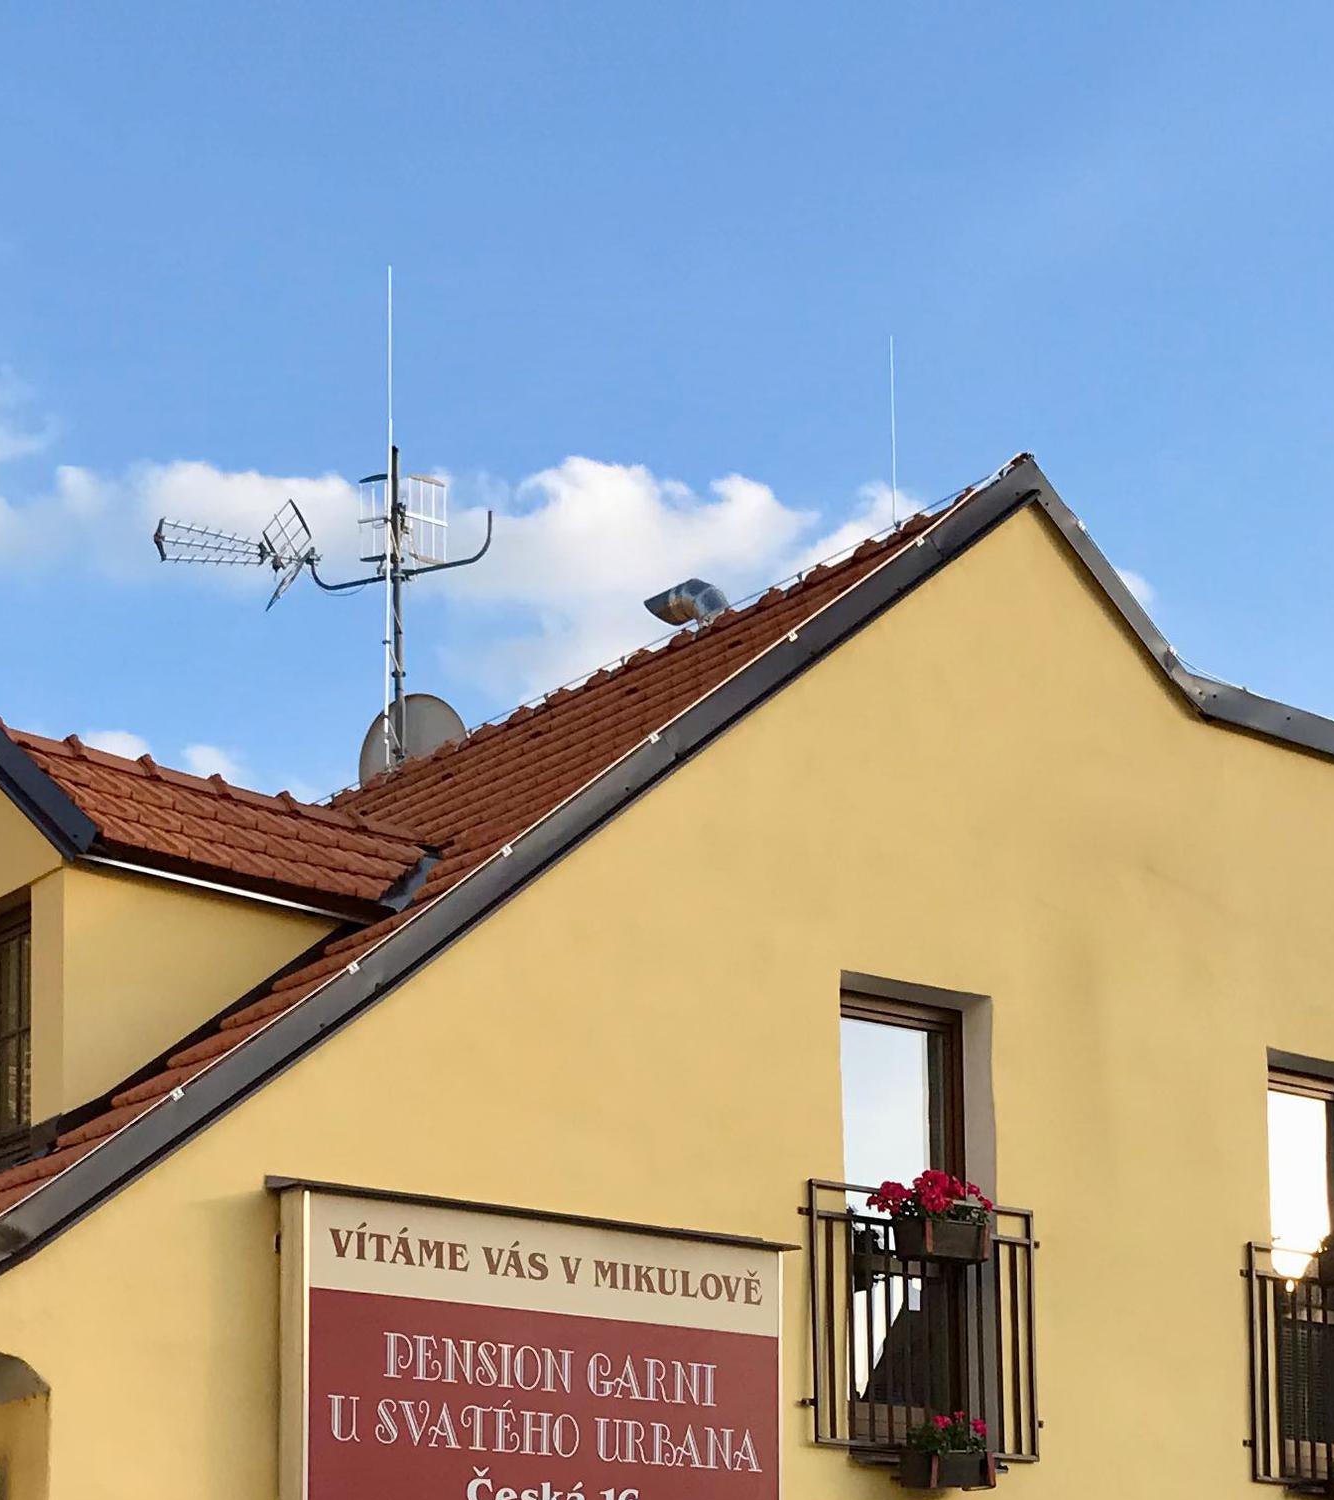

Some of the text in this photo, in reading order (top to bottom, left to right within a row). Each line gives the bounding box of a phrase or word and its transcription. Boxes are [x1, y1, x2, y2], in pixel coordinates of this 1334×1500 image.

[328, 1223, 764, 1306] VÍTÁME VÁS V MIKULOVĚ
[382, 1331, 718, 1407] PENSION GARNI
[327, 1394, 764, 1473] U SVATÉHO URBANA
